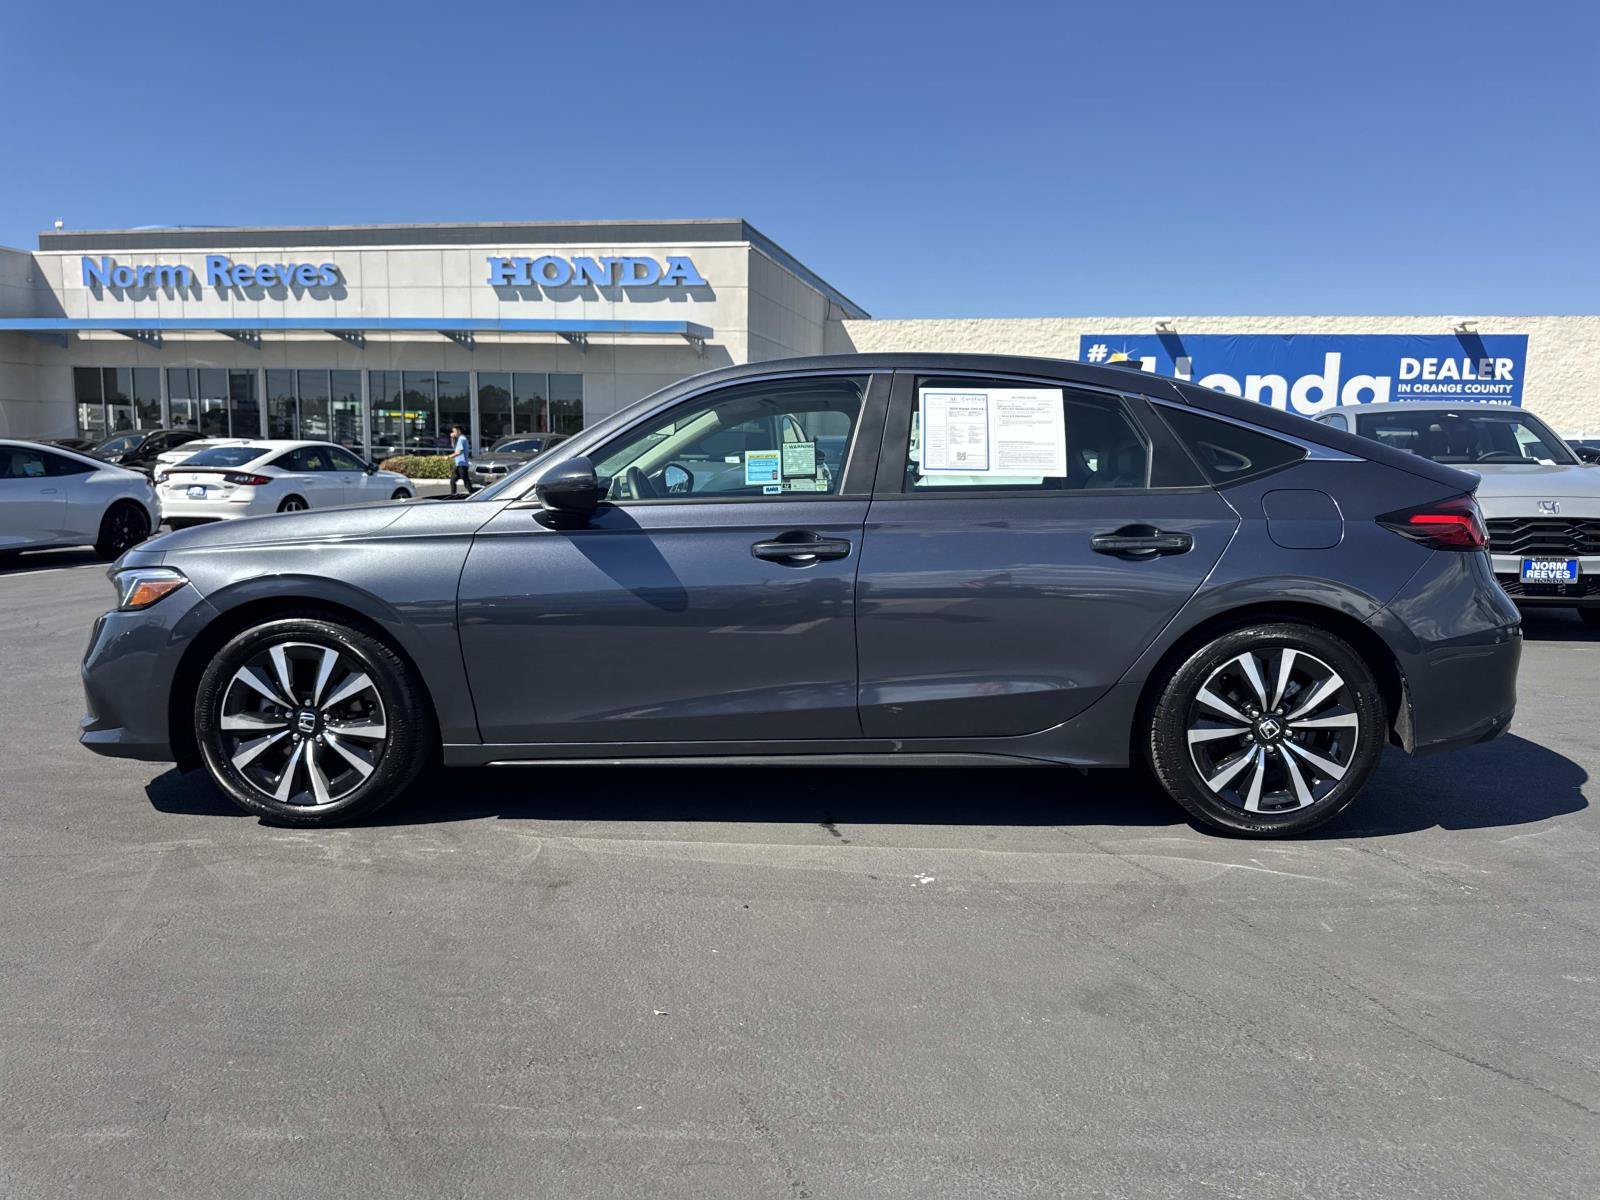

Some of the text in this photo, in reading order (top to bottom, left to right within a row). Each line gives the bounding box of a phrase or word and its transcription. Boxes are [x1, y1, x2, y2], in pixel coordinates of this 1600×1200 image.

[81, 254, 341, 288] Norm Reeves
[487, 256, 708, 288] HONDA
[1399, 358, 1514, 380] DEALER
[1140, 352, 1391, 416] nda
[1398, 384, 1513, 394] IN ORANGE COUNTY
[1526, 570, 1571, 579] REEVES
[1531, 561, 1567, 570] NORM
